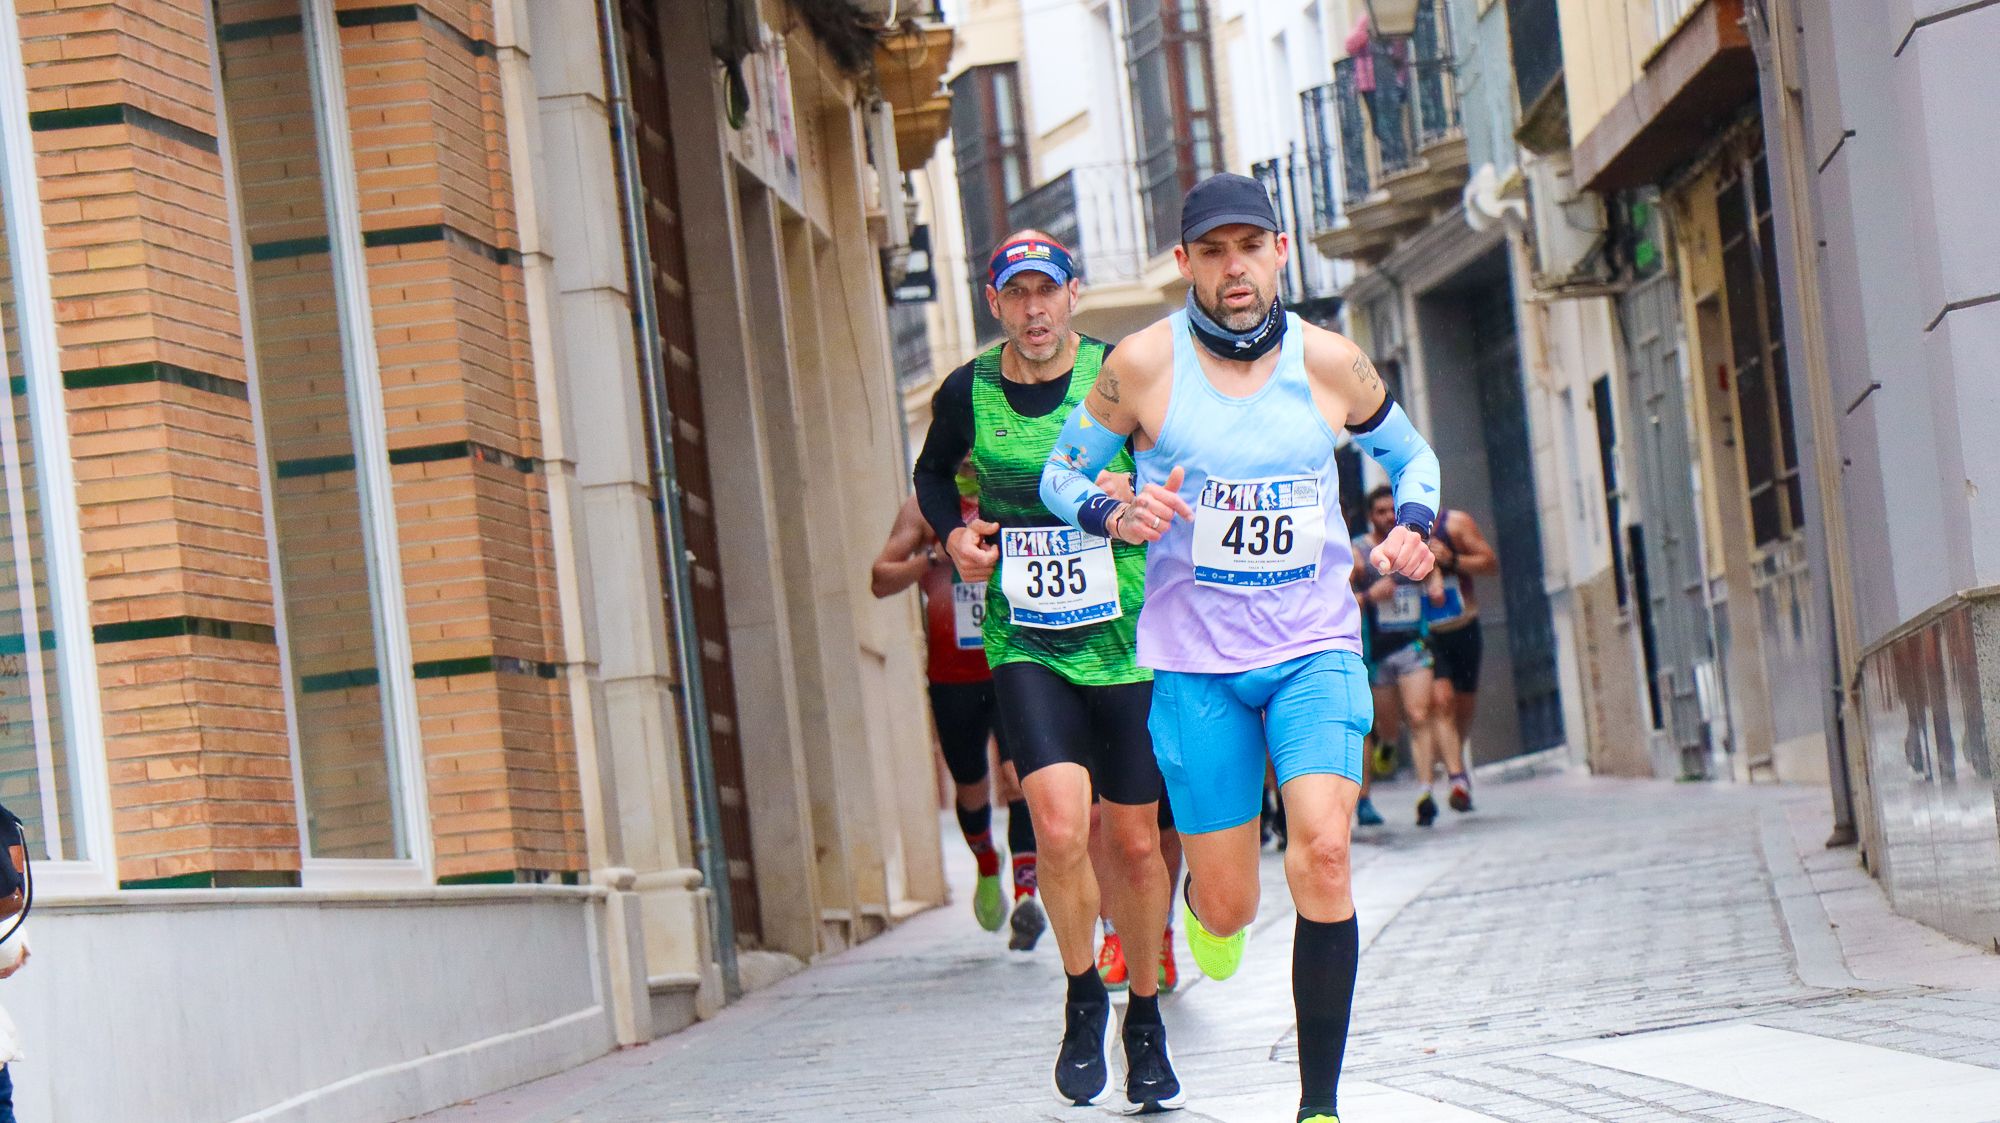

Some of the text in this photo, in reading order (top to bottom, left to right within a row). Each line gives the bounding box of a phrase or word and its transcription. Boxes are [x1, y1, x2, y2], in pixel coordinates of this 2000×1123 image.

[1216, 483, 1257, 510] 21K
[1017, 531, 1050, 556] 21K
[1222, 515, 1293, 555] 436
[1027, 557, 1087, 598] 335
[972, 604, 985, 627] 9
